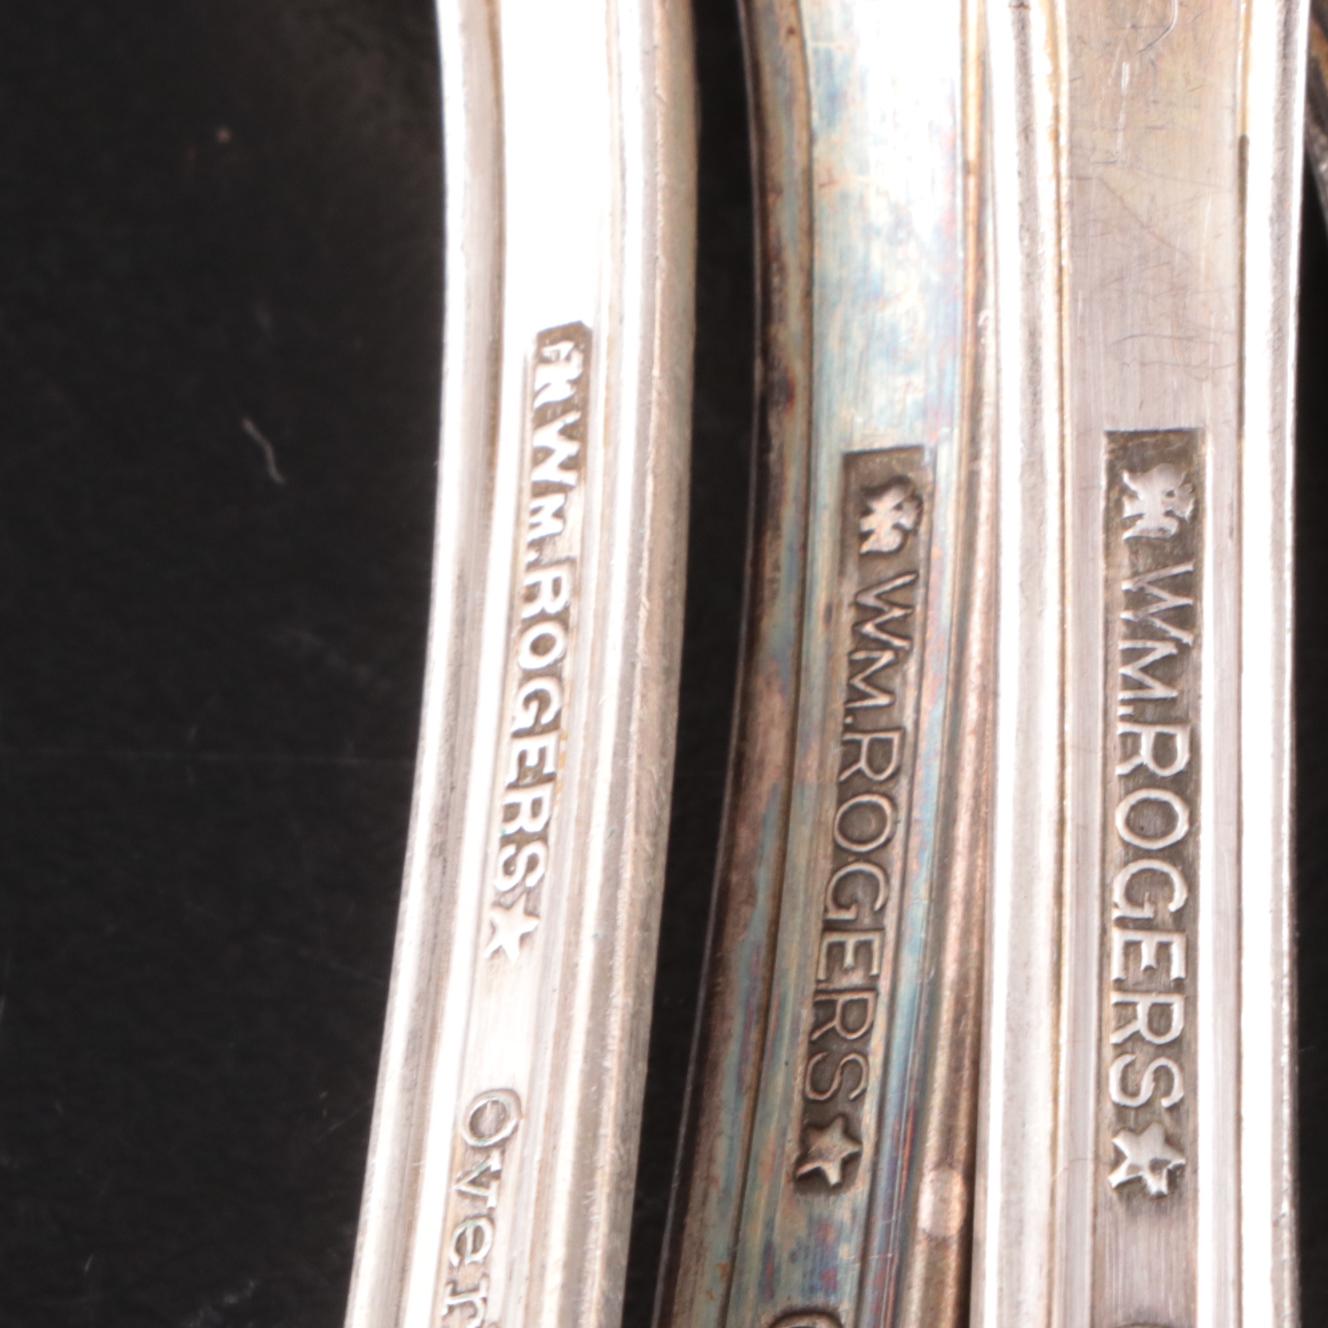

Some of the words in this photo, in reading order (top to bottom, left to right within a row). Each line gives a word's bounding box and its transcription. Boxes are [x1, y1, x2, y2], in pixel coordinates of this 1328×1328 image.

[493, 564, 573, 893] ROGERS
[804, 729, 905, 1102] ROGERS
[1108, 722, 1192, 1109] ROGERS
